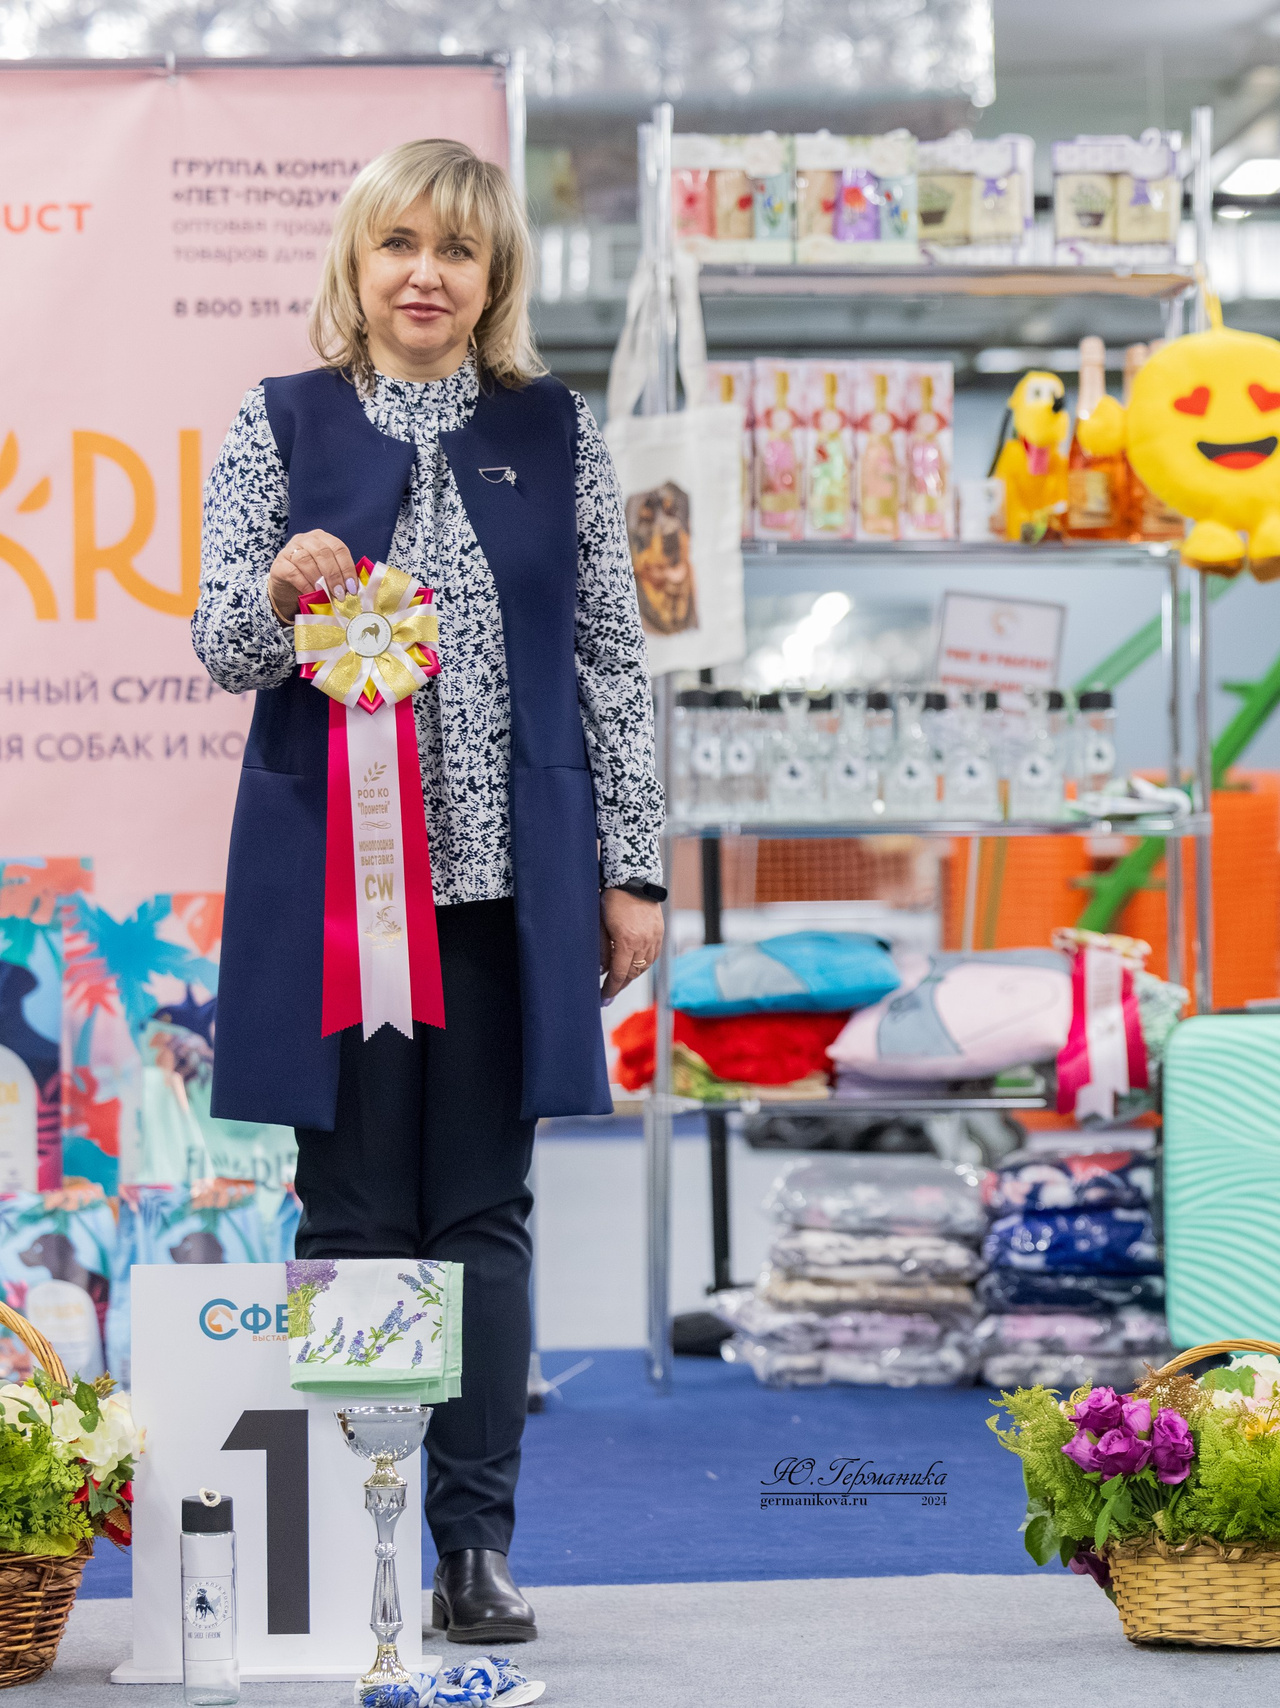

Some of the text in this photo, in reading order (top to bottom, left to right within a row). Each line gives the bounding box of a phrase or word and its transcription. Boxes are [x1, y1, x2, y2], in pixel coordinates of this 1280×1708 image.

[172, 158, 267, 177] ГРУППА
[3, 201, 93, 233] UCT
[34, 732, 153, 762] СОБАК
[164, 733, 189, 760] И
[357, 787, 389, 799] РОО КО
[360, 854, 395, 867] выставка
[364, 872, 394, 902] CW
[199, 1298, 289, 1341] СФЕ
[252, 1334, 288, 1342] ВЫСТАВ
[220, 1409, 311, 1635] 1
